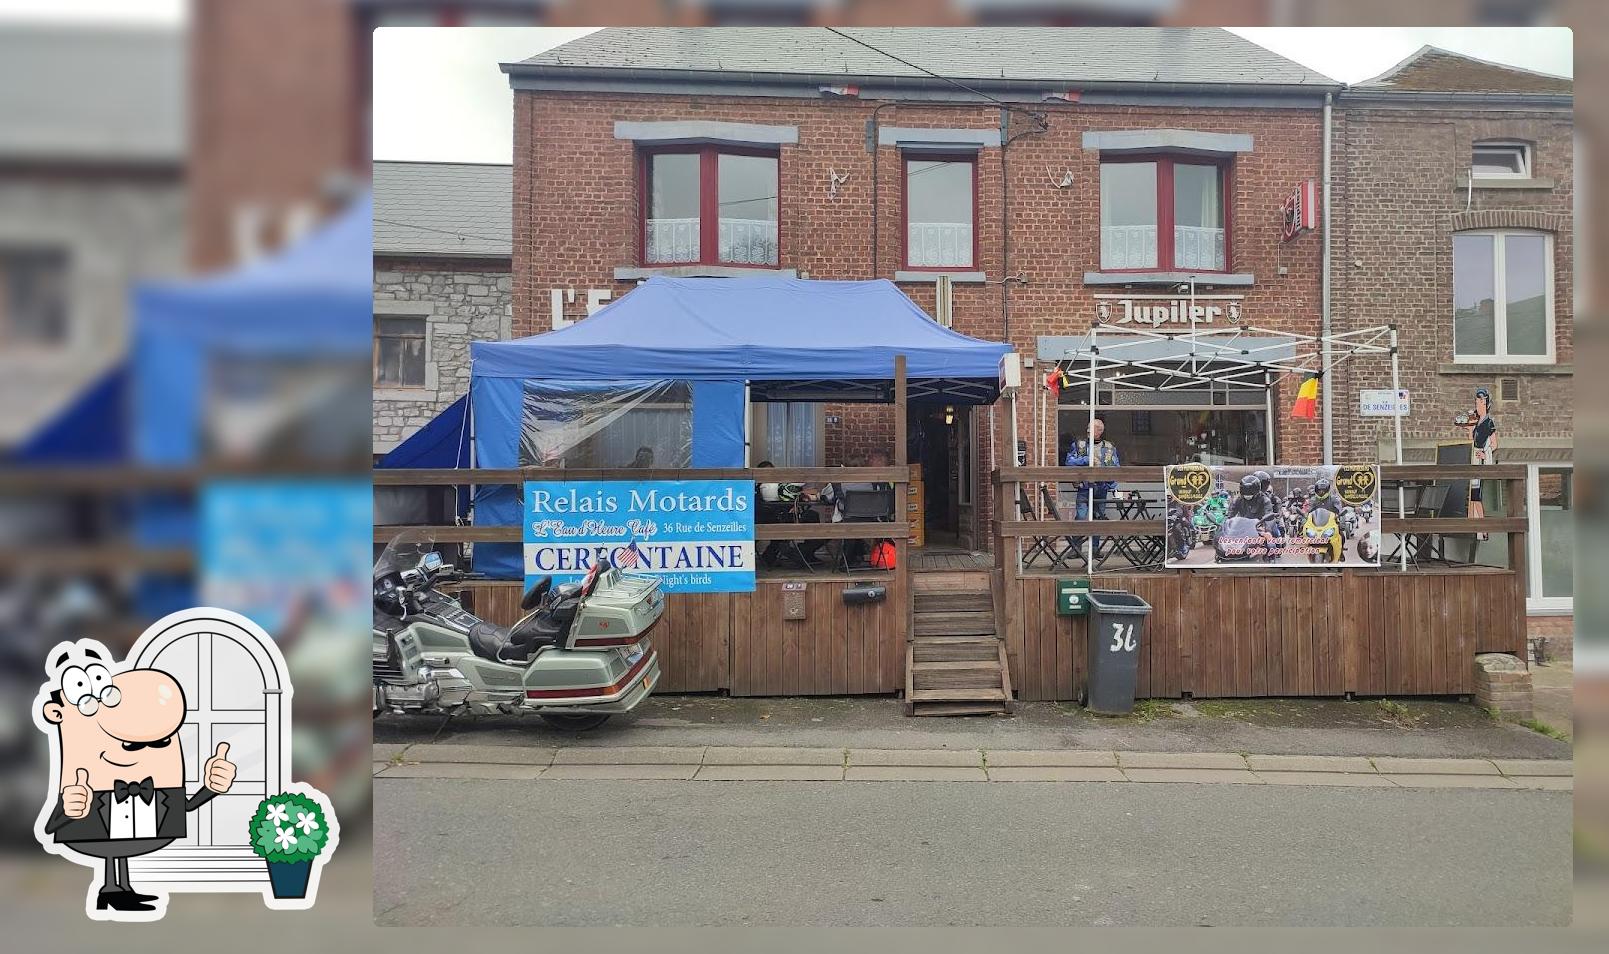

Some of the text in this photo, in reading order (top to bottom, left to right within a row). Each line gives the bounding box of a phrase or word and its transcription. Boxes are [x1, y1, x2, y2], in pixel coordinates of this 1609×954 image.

[1115, 299, 1222, 329] Jupiler
[532, 487, 748, 514] Relais Motards
[626, 518, 658, 541] Café
[663, 521, 747, 533] 36 Rue de Senzeilles
[690, 573, 712, 585] birds
[1109, 622, 1137, 652] 36
